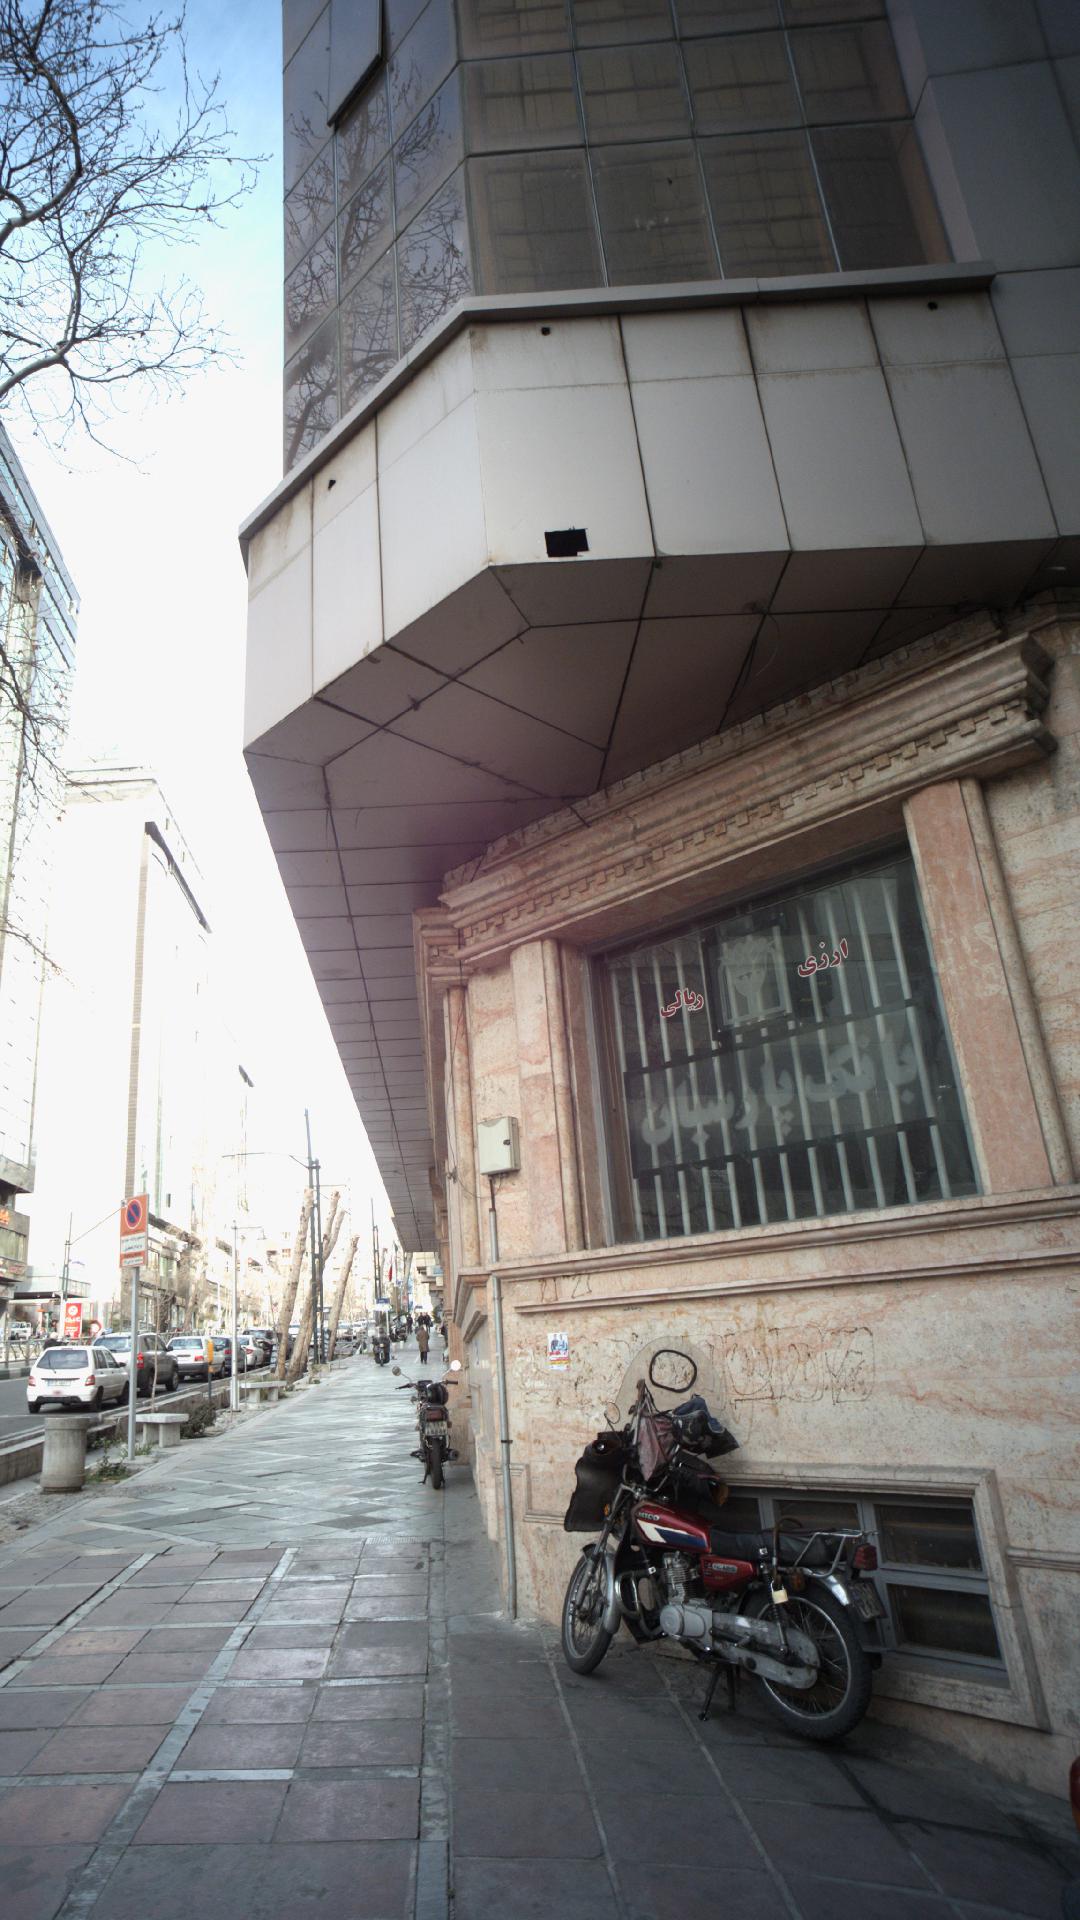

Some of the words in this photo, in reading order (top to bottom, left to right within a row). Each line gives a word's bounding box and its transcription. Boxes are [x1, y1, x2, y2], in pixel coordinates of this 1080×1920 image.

[798, 938, 849, 977] ارزی
[660, 987, 704, 1018] ریالی
[805, 1030, 919, 1104] بانک
[641, 1057, 795, 1146] پارسیان
